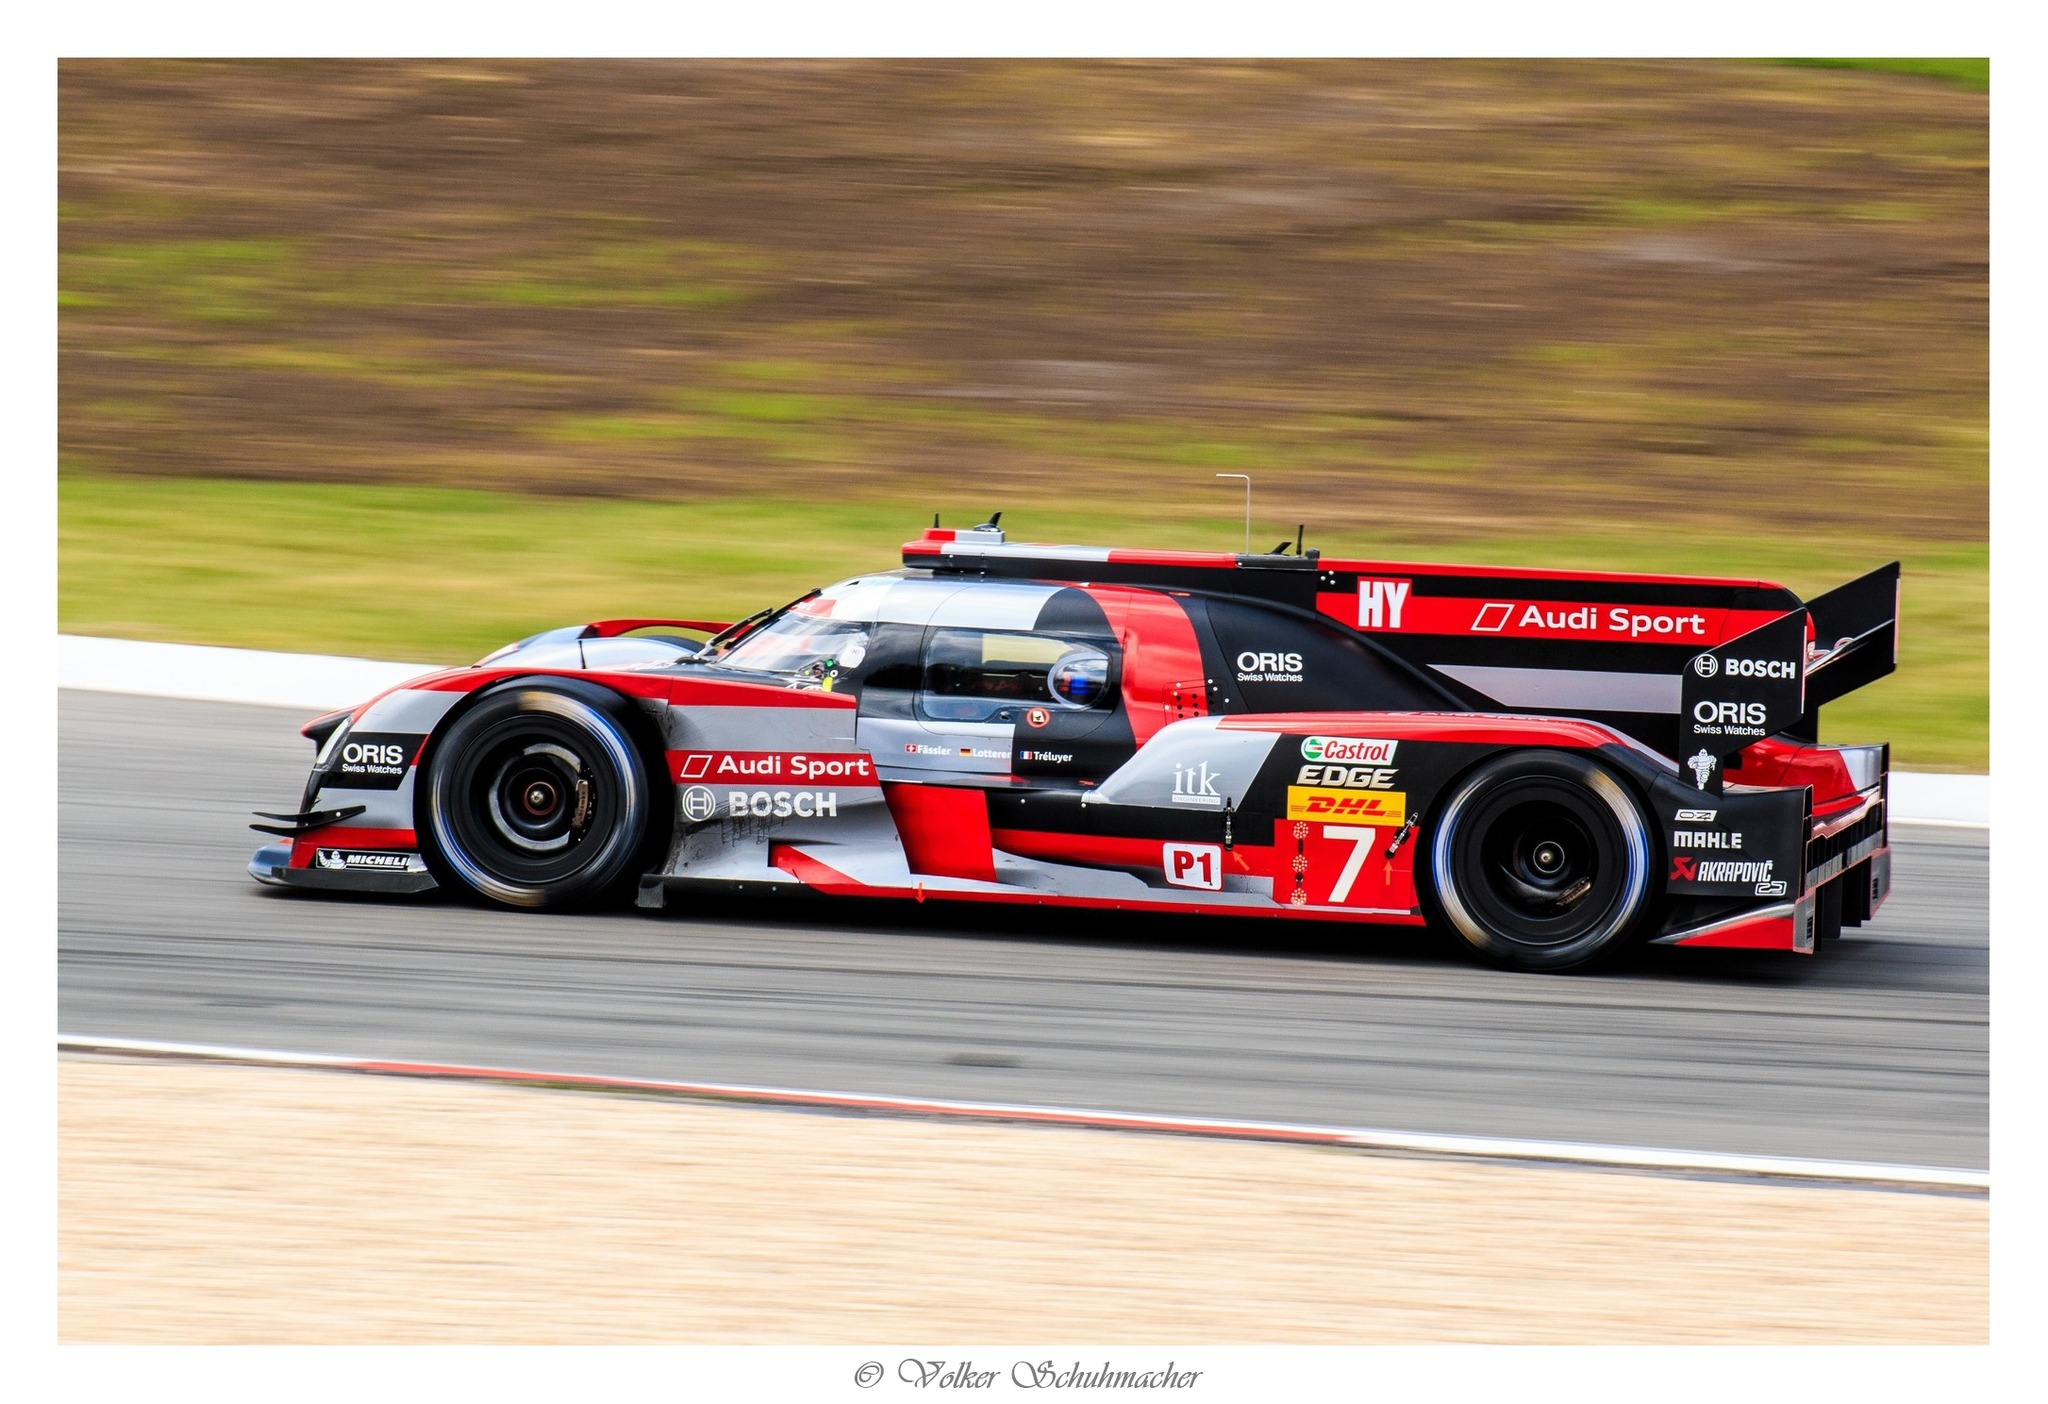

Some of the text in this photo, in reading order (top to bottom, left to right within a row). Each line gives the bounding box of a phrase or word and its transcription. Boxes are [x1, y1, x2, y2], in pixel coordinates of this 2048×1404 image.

[1358, 580, 1410, 628] HY
[1518, 604, 1706, 637] Audi Sport
[1237, 652, 1303, 672] ORIS
[1725, 659, 1796, 679] BOSCH
[1237, 672, 1303, 682] Swiss Watches
[1693, 700, 1766, 725] ORIS
[1693, 724, 1766, 736] Swiss Watches
[342, 743, 403, 764] ORIS
[918, 744, 951, 755] Fässler
[972, 747, 1012, 759] Lotterer
[1034, 751, 1073, 763] Tréluyer
[1323, 740, 1390, 762] Castrol
[341, 764, 403, 774] Swiss Watches
[717, 755, 870, 781] Audi Sport
[1172, 760, 1221, 796] itk
[1296, 765, 1400, 789] EDGE
[729, 790, 837, 818] BOSCH
[1173, 796, 1219, 804] ENGINEERING
[1306, 796, 1388, 816] DHL
[1673, 831, 1743, 849] MAHLE
[1173, 850, 1213, 883] P1
[1322, 825, 1376, 903] 7
[1697, 860, 1773, 882] AKRAPOVIČ
